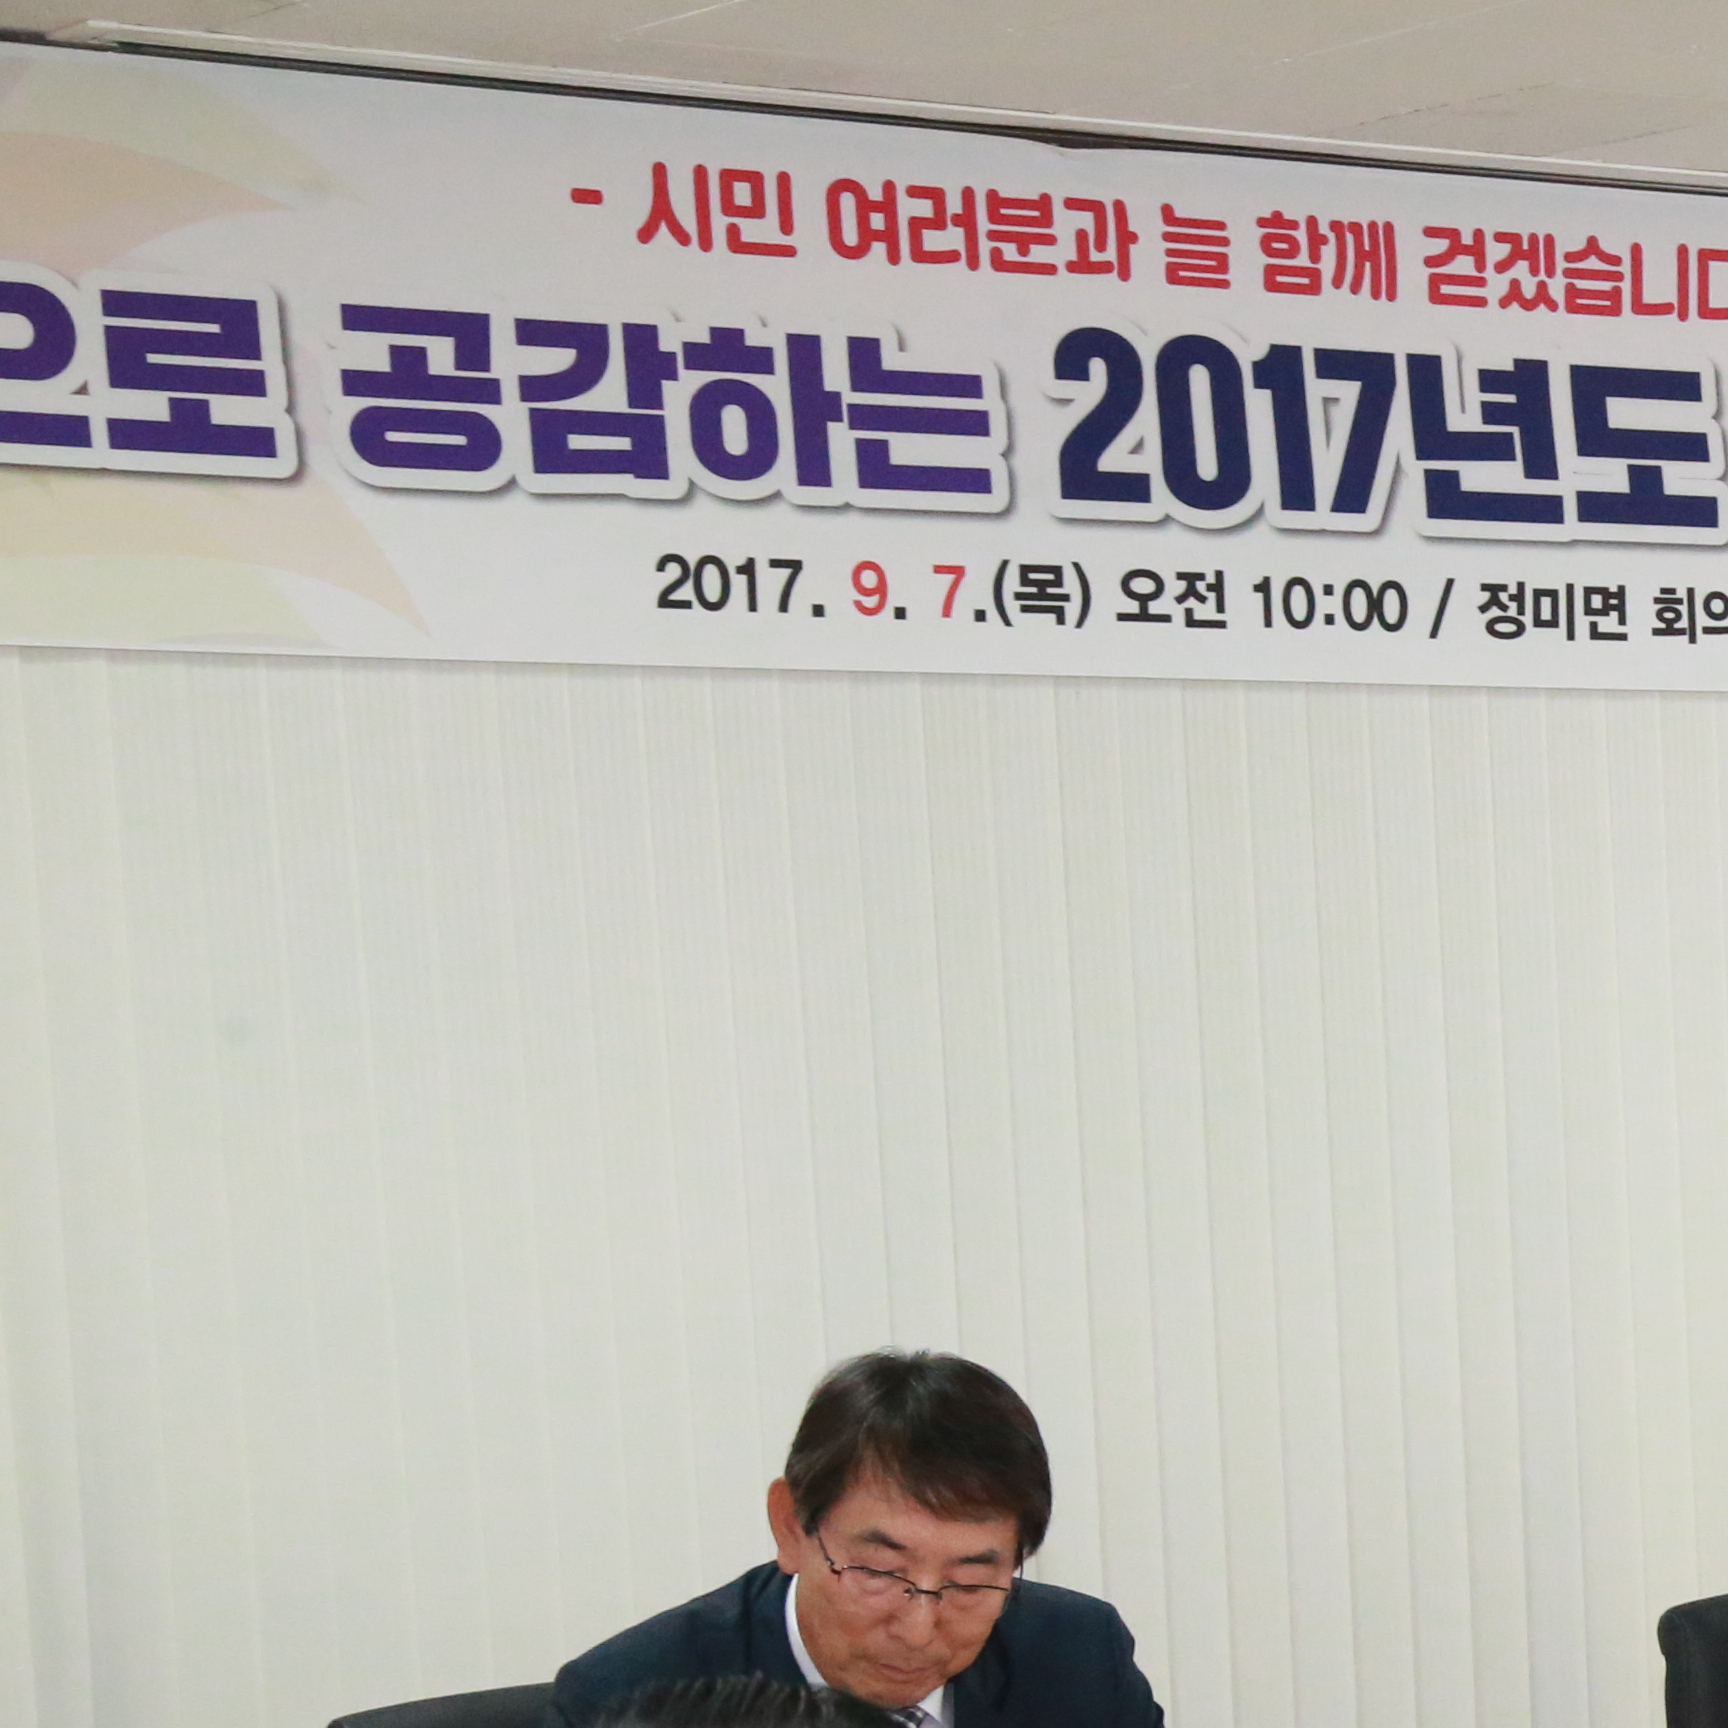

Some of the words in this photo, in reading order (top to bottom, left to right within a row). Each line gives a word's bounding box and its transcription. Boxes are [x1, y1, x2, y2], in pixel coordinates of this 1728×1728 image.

[637, 162, 797, 257] 시민
[826, 179, 1138, 283] 여러분과
[1161, 204, 1231, 289] 늘
[1256, 211, 1398, 302] 함께
[341, 304, 991, 493] 공감하는
[1054, 328, 1718, 527] 2017년도
[1116, 568, 1227, 629] 오전
[1253, 576, 1408, 634] 10:00
[1477, 582, 1628, 642] 정미면
